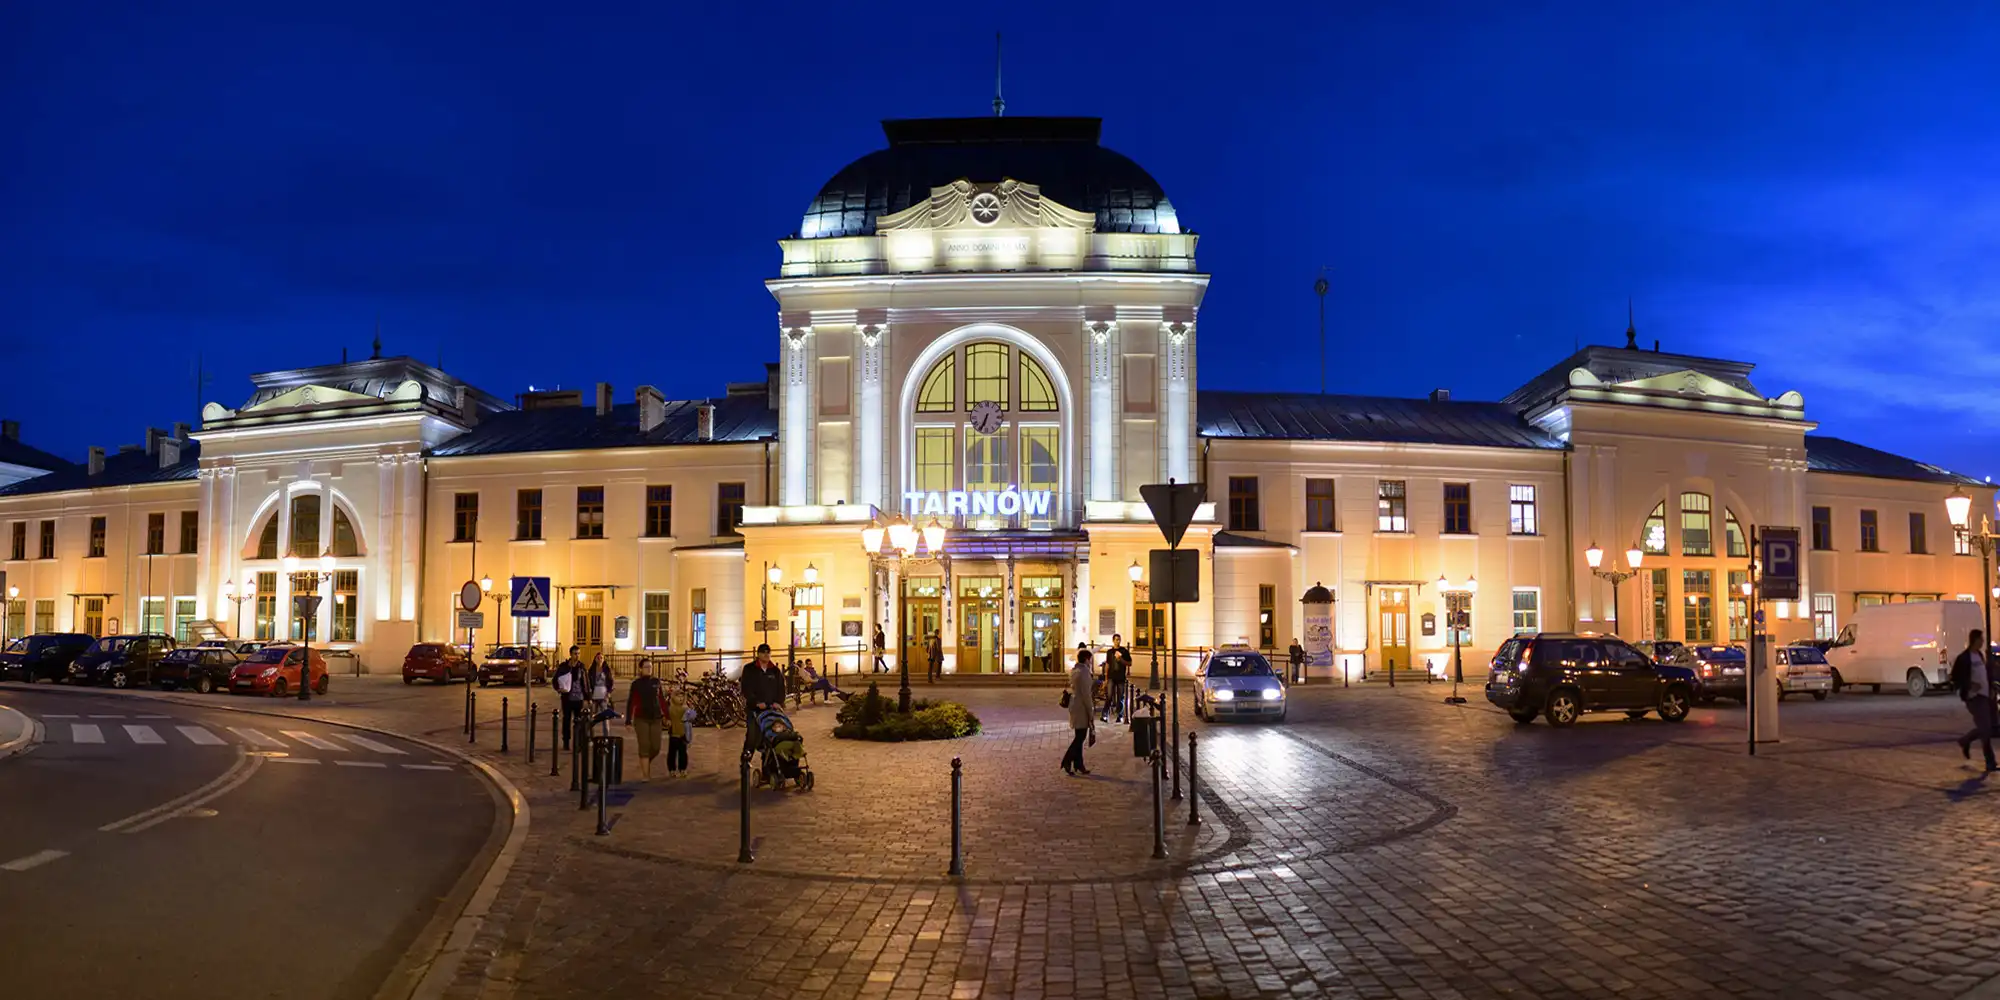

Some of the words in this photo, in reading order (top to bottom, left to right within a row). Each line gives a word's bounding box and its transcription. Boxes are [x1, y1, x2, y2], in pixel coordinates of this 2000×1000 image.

[948, 244, 969, 252] ANNO
[973, 243, 1000, 251] DOMINI
[904, 484, 1051, 515] TARNÓW
[1769, 543, 1791, 574] P
